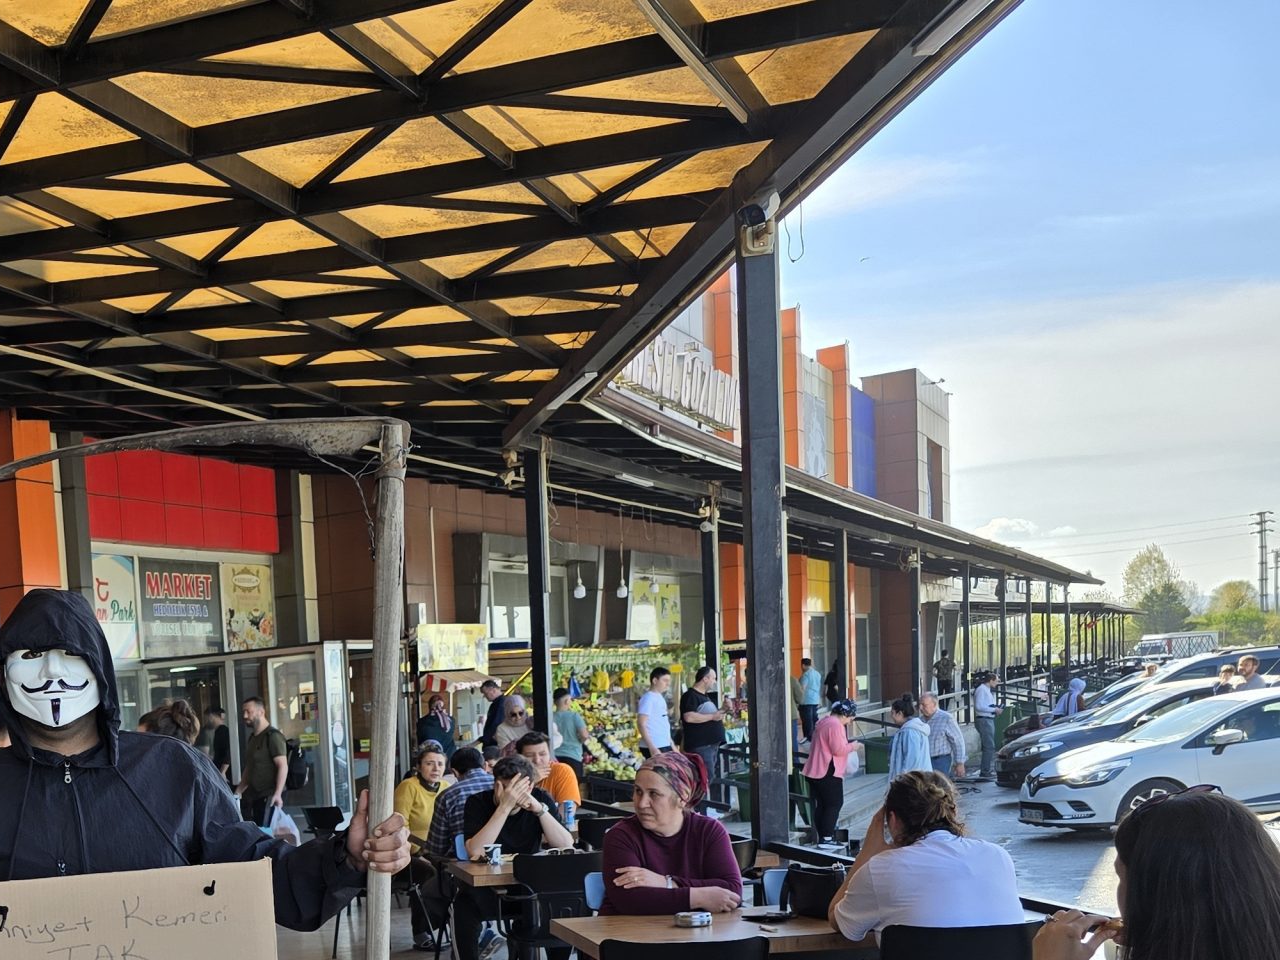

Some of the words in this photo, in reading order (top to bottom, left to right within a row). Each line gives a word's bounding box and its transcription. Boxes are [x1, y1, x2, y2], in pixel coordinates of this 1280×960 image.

[145, 571, 212, 600] MARKET
[111, 599, 134, 621] Park
[121, 896, 228, 928] Kemeri
